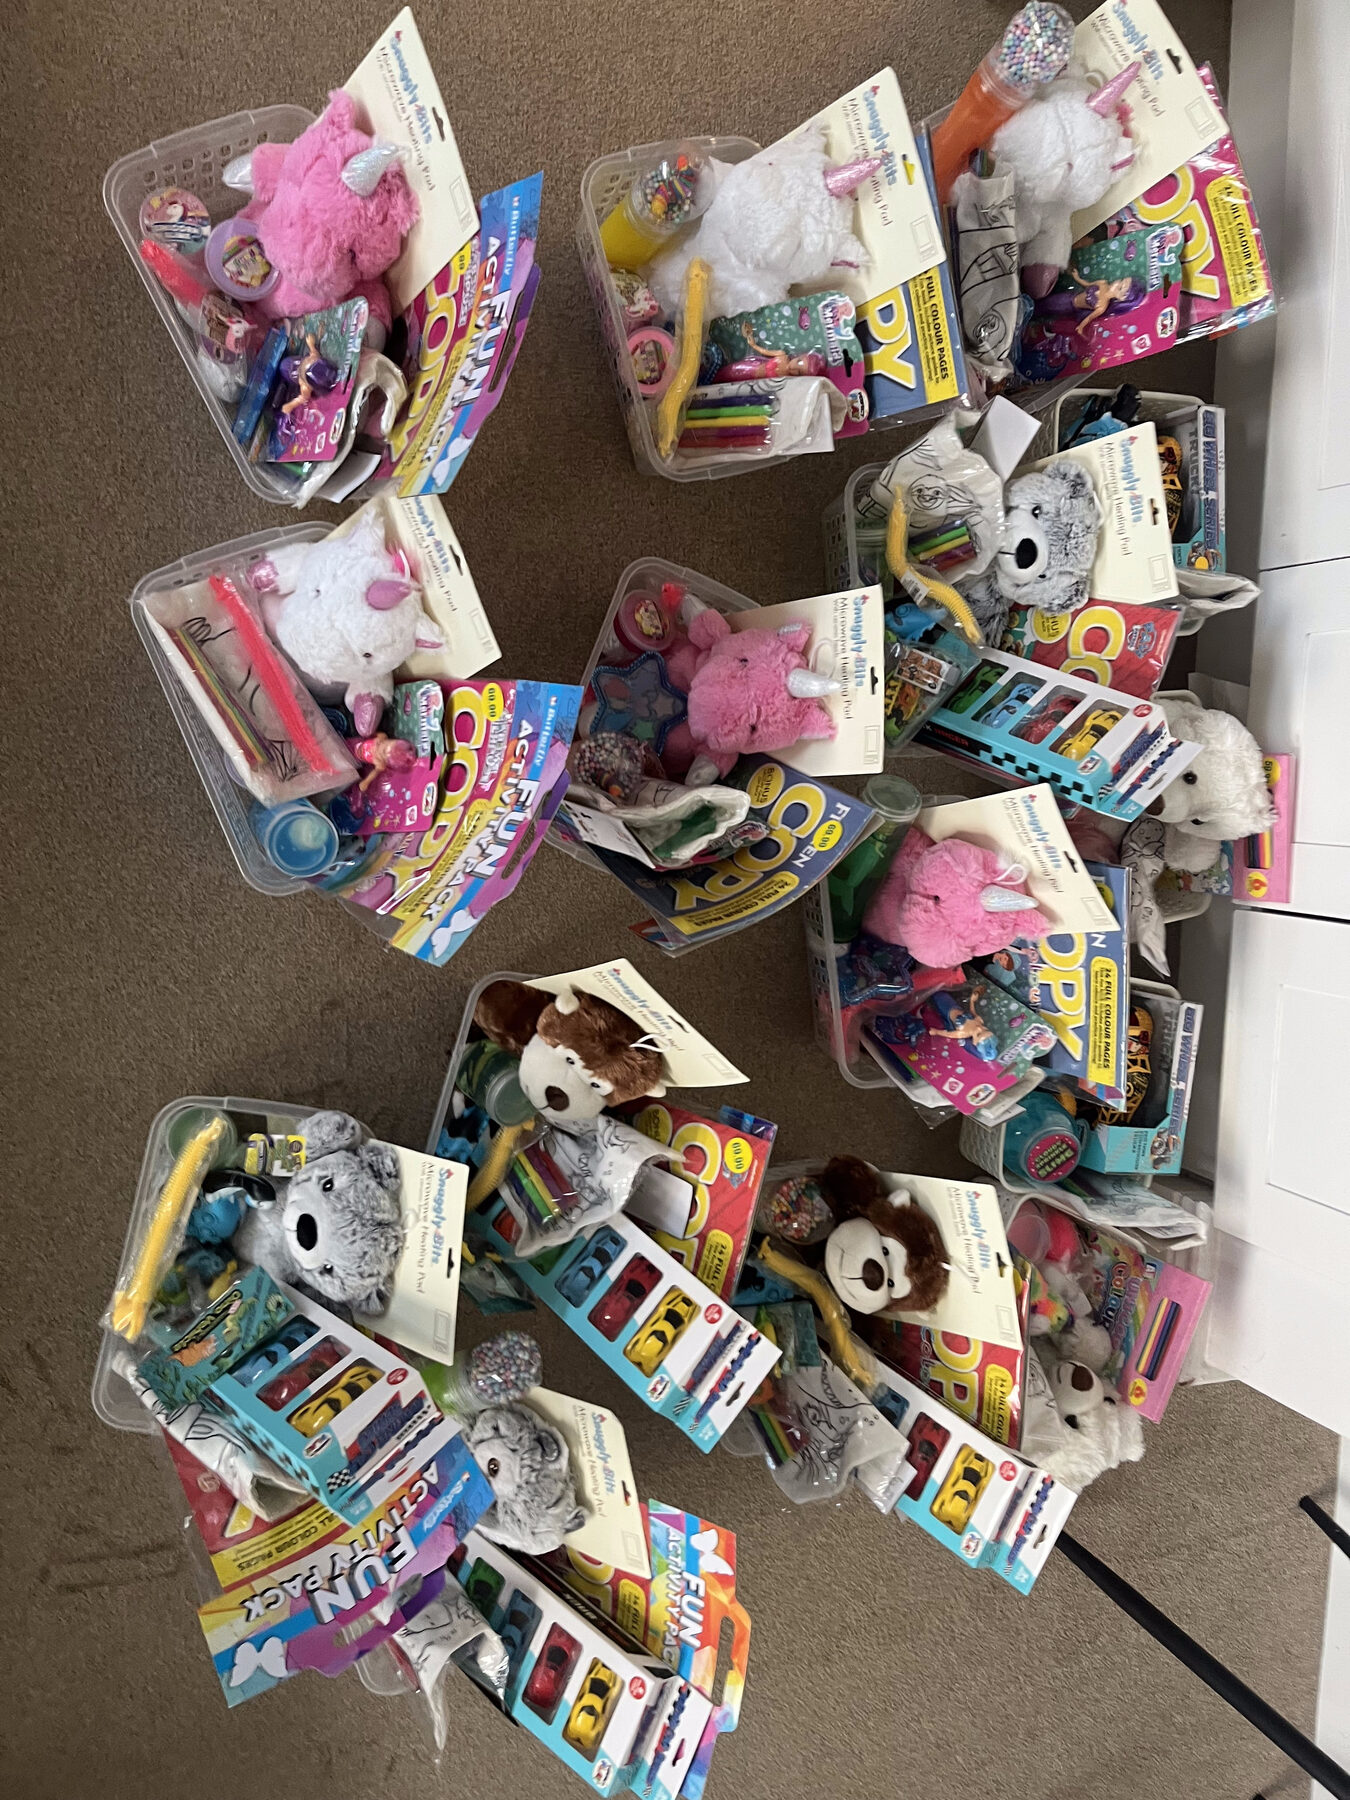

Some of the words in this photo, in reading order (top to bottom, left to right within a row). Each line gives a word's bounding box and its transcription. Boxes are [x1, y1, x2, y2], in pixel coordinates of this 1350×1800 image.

[1112, 2, 1148, 53] Snuggly
[1095, 13, 1130, 62] Microwave
[1149, 97, 1165, 117] Pad
[862, 89, 890, 152] Snuggly
[880, 151, 898, 186] Bits
[422, 166, 436, 191] Pad
[870, 175, 882, 204] ating
[877, 204, 892, 226] Pad
[504, 209, 520, 276] Butterfly
[1134, 165, 1220, 300] OPY
[1236, 222, 1252, 260] COLOUR
[455, 236, 501, 387] ACTIVITY
[925, 276, 936, 301] FULL
[457, 289, 512, 408] FUN
[856, 285, 917, 390] PY
[930, 303, 943, 345] COLOUR
[1160, 313, 1169, 335] PLAY
[937, 348, 949, 380] PAGES
[1105, 442, 1121, 495] Microwave
[1119, 438, 1141, 492] Snuggly
[1115, 497, 1126, 535] Heating
[1120, 538, 1132, 557] Pad
[444, 591, 457, 613] Pad
[840, 597, 848, 654] Microwave
[850, 596, 867, 653] Snuggly
[854, 657, 867, 687] Bits
[1058, 606, 1126, 687] CO
[840, 656, 850, 698] Heating
[843, 700, 853, 720] Pad
[534, 708, 557, 767] Butterfly
[476, 720, 534, 853] ACTIVITY
[760, 767, 775, 804] BONUS
[472, 778, 541, 880] FUN
[1020, 794, 1050, 843] Snuggly
[1007, 796, 1033, 844] Microwave
[1029, 845, 1050, 877] Heating
[1048, 878, 1065, 894] Pad
[422, 857, 476, 922] PACK
[1038, 933, 1087, 1062] OPY
[422, 1163, 435, 1223] Microwave
[431, 1168, 450, 1228] Snuggly
[966, 1191, 987, 1240] Snuggly
[417, 1225, 429, 1268] Heating
[431, 1233, 444, 1265] Bits
[952, 1187, 969, 1236] Microwave
[963, 1238, 976, 1274] Heating
[416, 1272, 426, 1294] Pad
[712, 1257, 725, 1281] FULL
[997, 1390, 1008, 1414] FULL
[591, 1413, 611, 1463] Snuggly
[422, 1480, 464, 1532] Butterfly
[586, 1459, 601, 1496] Heating
[594, 1498, 608, 1518] Pad
[272, 1522, 324, 1556] COLOUR
[330, 1460, 439, 1577] ACTIVITY
[237, 1550, 277, 1572] PAGES
[306, 1526, 418, 1624] FUN
[665, 1527, 682, 1620] ACTIVITY
[240, 1566, 324, 1622] PACK
[631, 1608, 639, 1632] FULL
[678, 1571, 706, 1649] FUN
[662, 1622, 679, 1662] PAC
